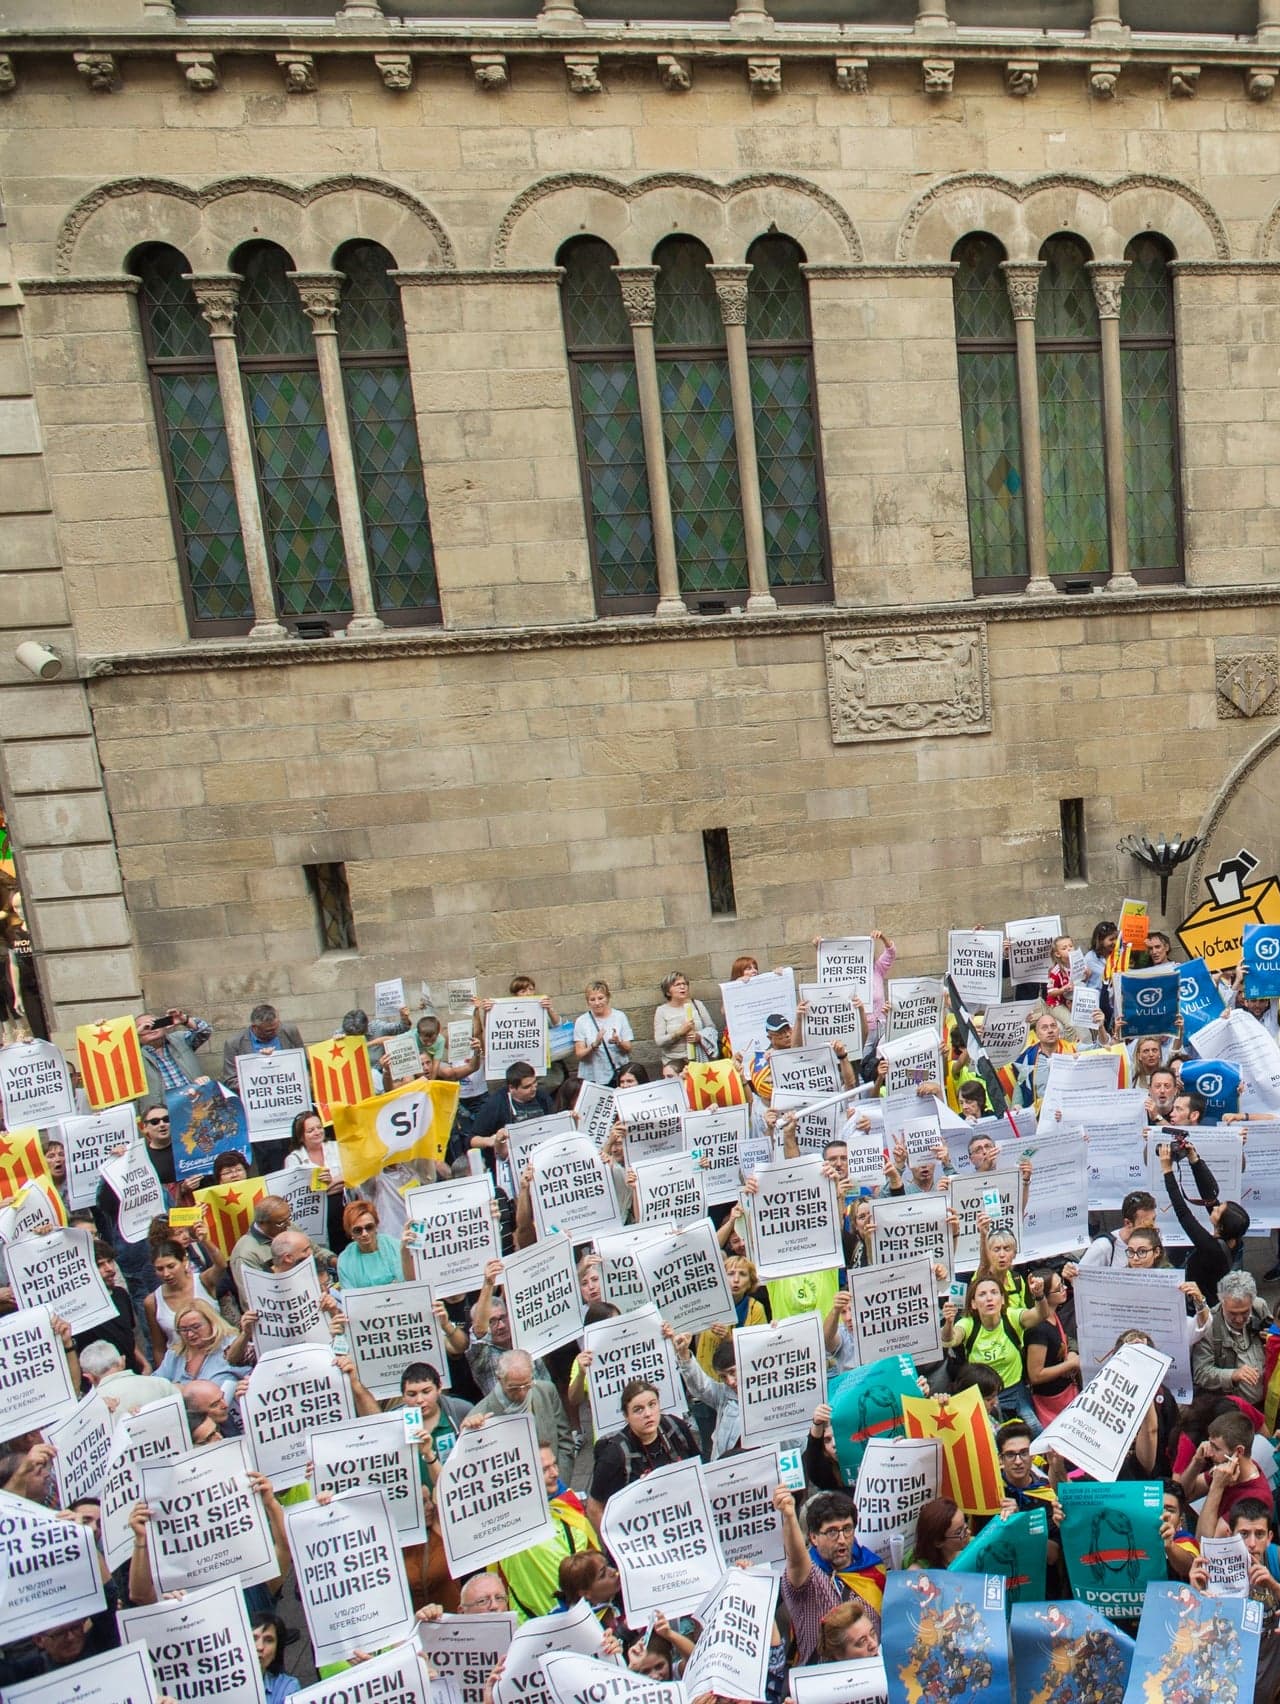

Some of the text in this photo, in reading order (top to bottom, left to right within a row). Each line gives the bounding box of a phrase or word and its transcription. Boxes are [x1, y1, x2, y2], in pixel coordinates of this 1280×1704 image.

[953, 959, 996, 969] PER SER
[958, 949, 993, 959] VOTEM
[954, 968, 996, 978] LLIURES
[1136, 1006, 1166, 1016] VULL!
[1182, 997, 1211, 1015] VULL!
[496, 1019, 536, 1028] VOTEM
[491, 1029, 540, 1039] PER SER
[492, 1040, 540, 1050] LLIURES
[8, 1060, 56, 1077] VOTEM
[251, 1072, 295, 1084] VOTEM
[7, 1071, 62, 1090] PER SER
[248, 1083, 302, 1098] PER SER
[9, 1083, 63, 1103] LLIURES
[250, 1096, 303, 1110] LLIURES
[763, 1187, 821, 1206] VOTEM
[759, 1198, 827, 1220] PER SER
[761, 1216, 828, 1237] LLIURES
[514, 1269, 570, 1304] LLIURES
[516, 1284, 573, 1314] PER SER
[359, 1312, 423, 1330] VOTEM
[522, 1306, 571, 1332] VOTEM
[357, 1325, 432, 1345] PER SER
[359, 1339, 434, 1362] LLIURES
[751, 1348, 810, 1371] VOTEM
[746, 1362, 816, 1389] PER SER
[748, 1379, 817, 1404] LLIURES
[158, 1476, 239, 1514] VOTEM
[156, 1496, 250, 1535] PER SER
[619, 1501, 692, 1537] VOTEM
[161, 1515, 254, 1555] LLIURES
[305, 1526, 376, 1560] VOTEM
[618, 1519, 703, 1555] PER SER
[304, 1546, 389, 1584] PER SER
[626, 1541, 707, 1570] LLIURES
[1209, 1554, 1242, 1566] VOTEM
[1208, 1562, 1245, 1576] PER SER
[1209, 1572, 1246, 1584] LLIURES
[309, 1570, 391, 1606] LLIURES
